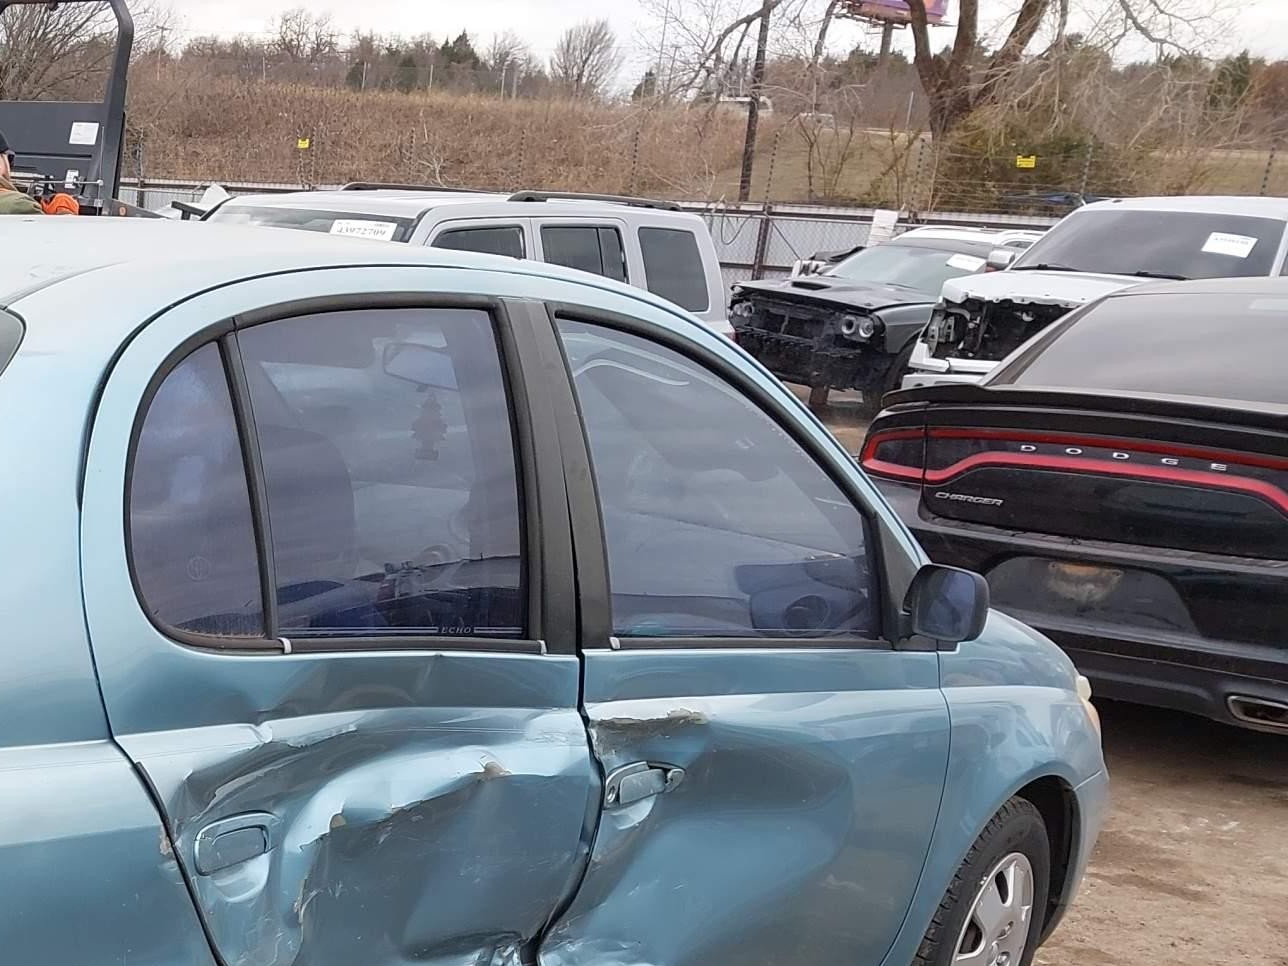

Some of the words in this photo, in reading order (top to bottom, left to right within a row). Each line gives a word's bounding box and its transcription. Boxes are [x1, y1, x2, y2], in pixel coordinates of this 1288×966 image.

[1020, 444, 1228, 472] DODGE
[935, 491, 1004, 506] CHARGER
[441, 626, 472, 634] ECHO
